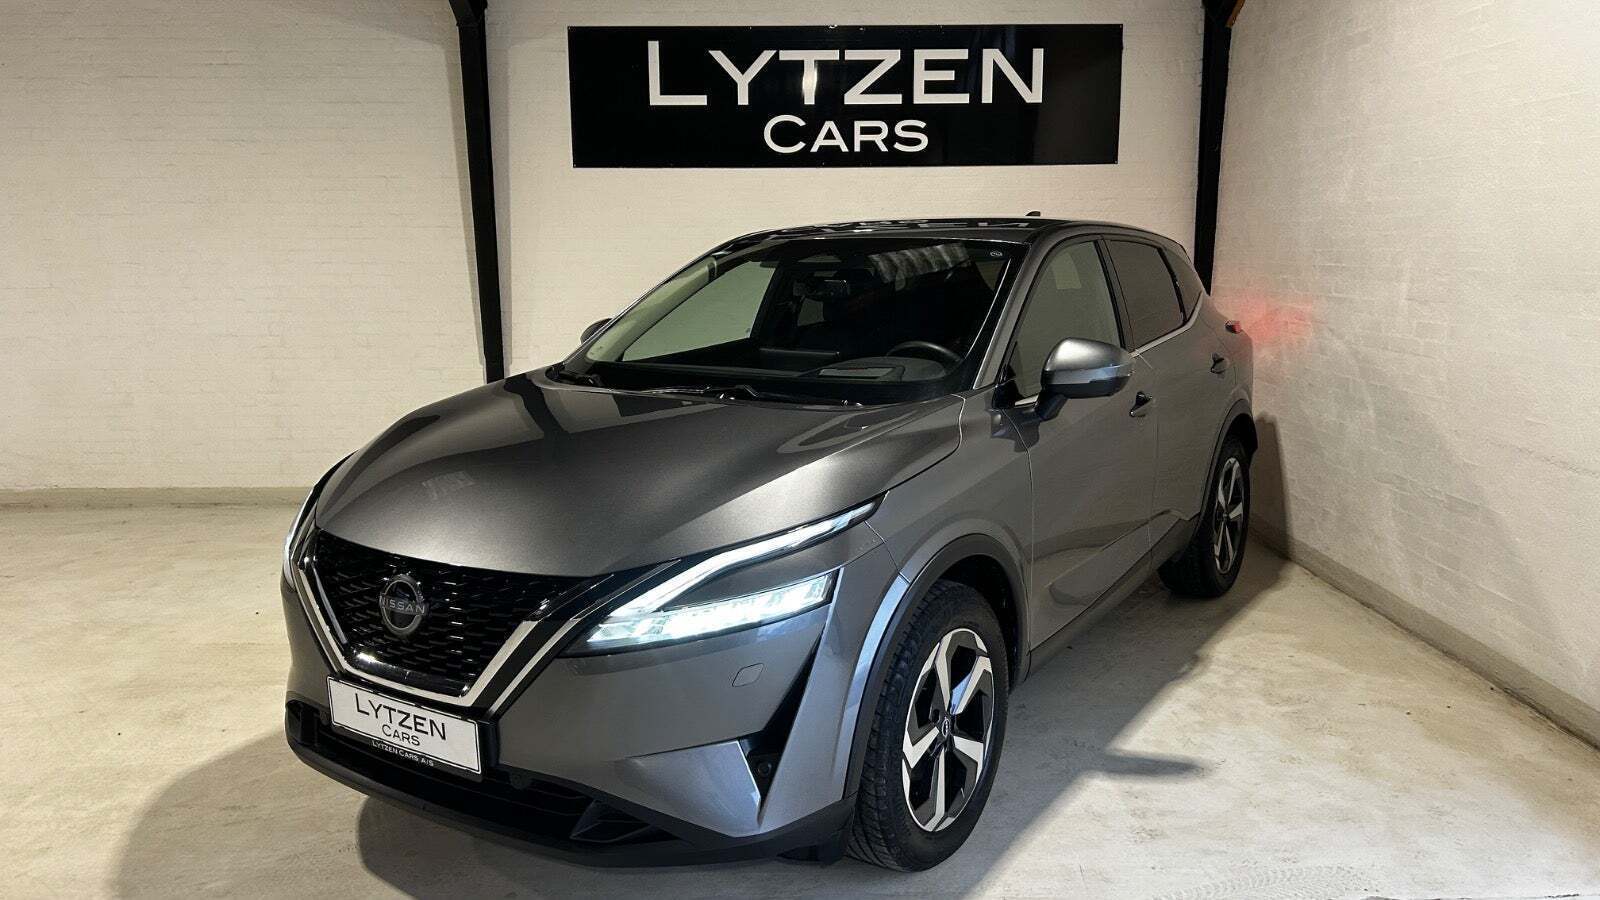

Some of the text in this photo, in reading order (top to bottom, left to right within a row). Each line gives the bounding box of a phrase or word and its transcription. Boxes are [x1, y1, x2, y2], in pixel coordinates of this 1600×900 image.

[647, 40, 1045, 106] LYTZEN
[763, 114, 929, 153] CARS
[379, 595, 425, 614] NISSAN
[354, 692, 447, 741] LYTZEN
[381, 724, 421, 747] CARS
[371, 740, 434, 767] LYTZEN CARS A/S
